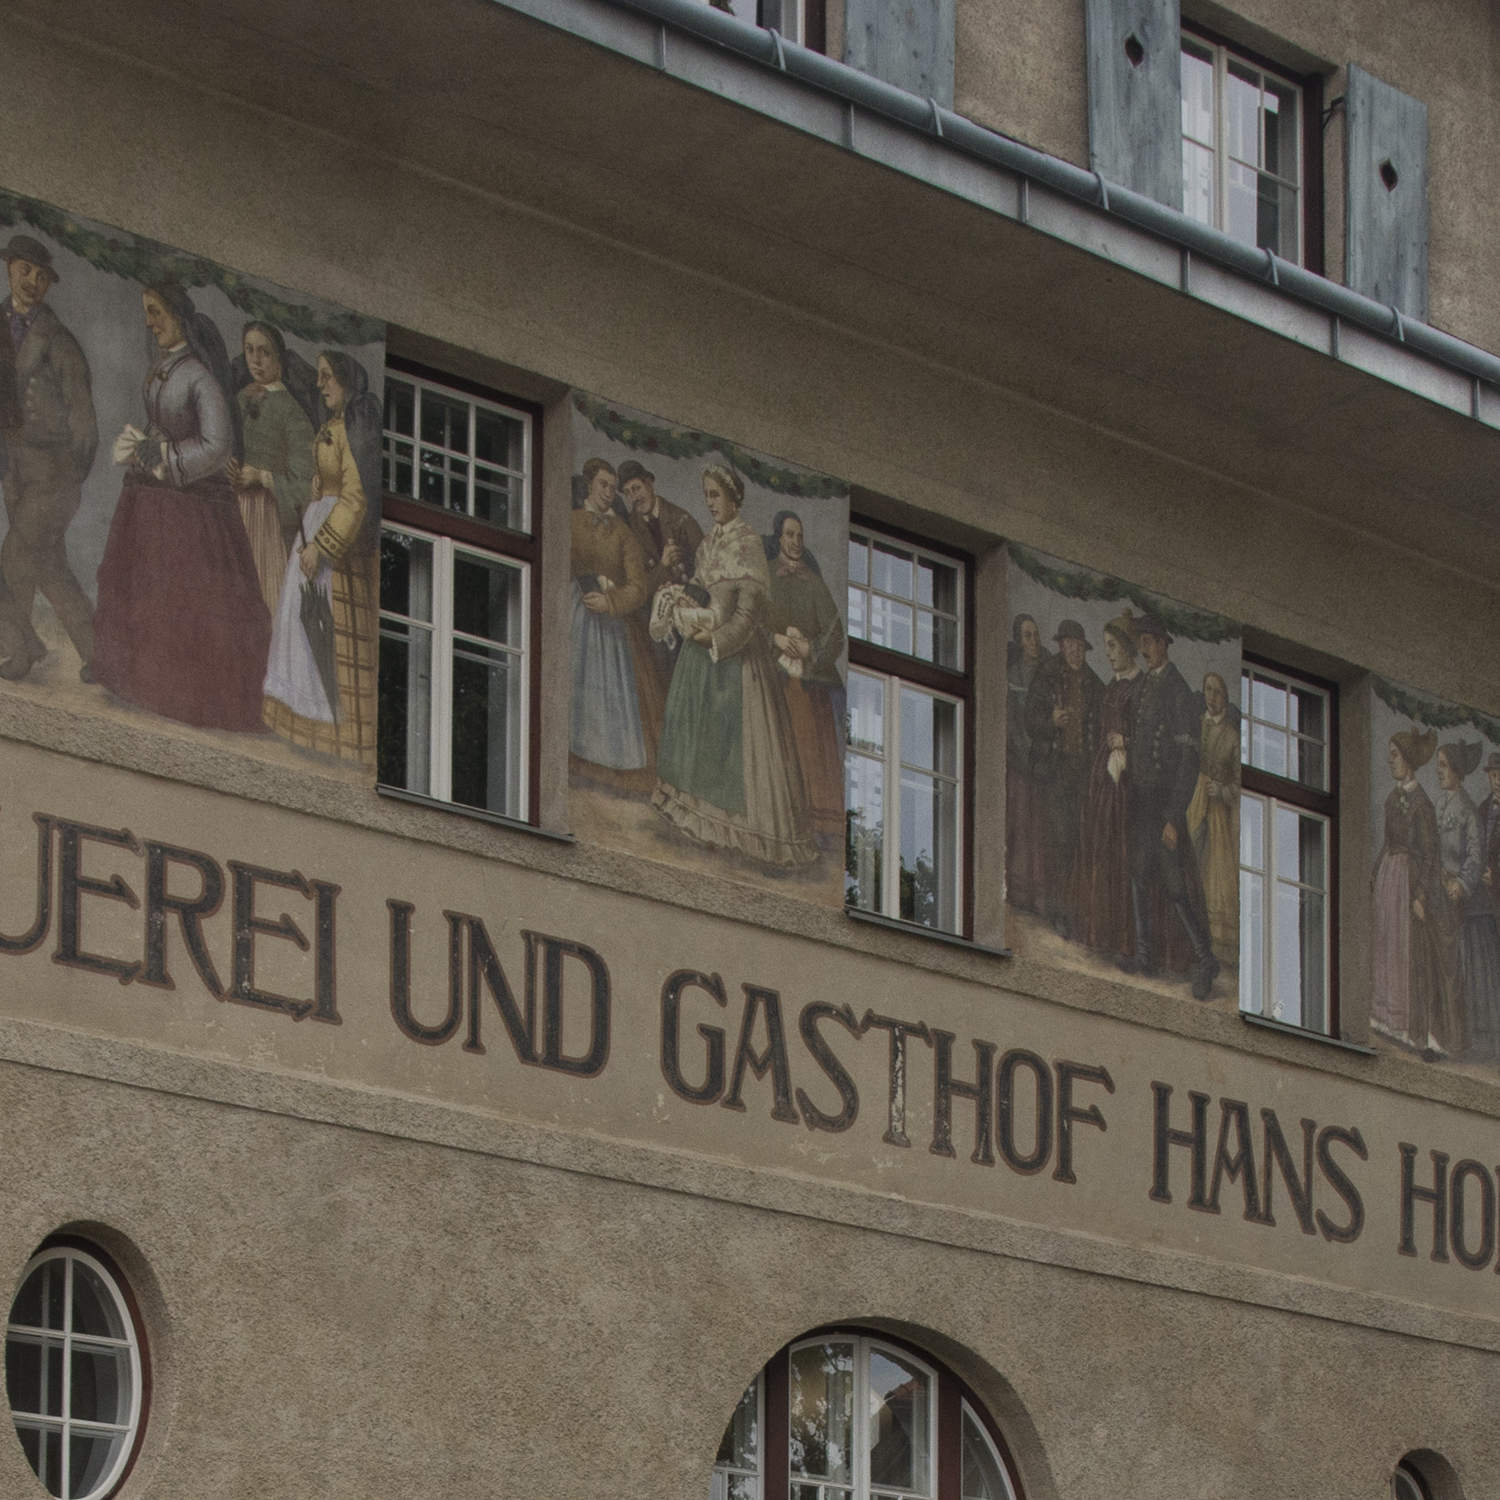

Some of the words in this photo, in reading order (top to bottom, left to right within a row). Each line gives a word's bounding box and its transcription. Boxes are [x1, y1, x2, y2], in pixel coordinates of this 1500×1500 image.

[386, 898, 612, 1080] UND
[657, 967, 1117, 1184] GASTHOF
[1148, 1080, 1370, 1245] HANS
